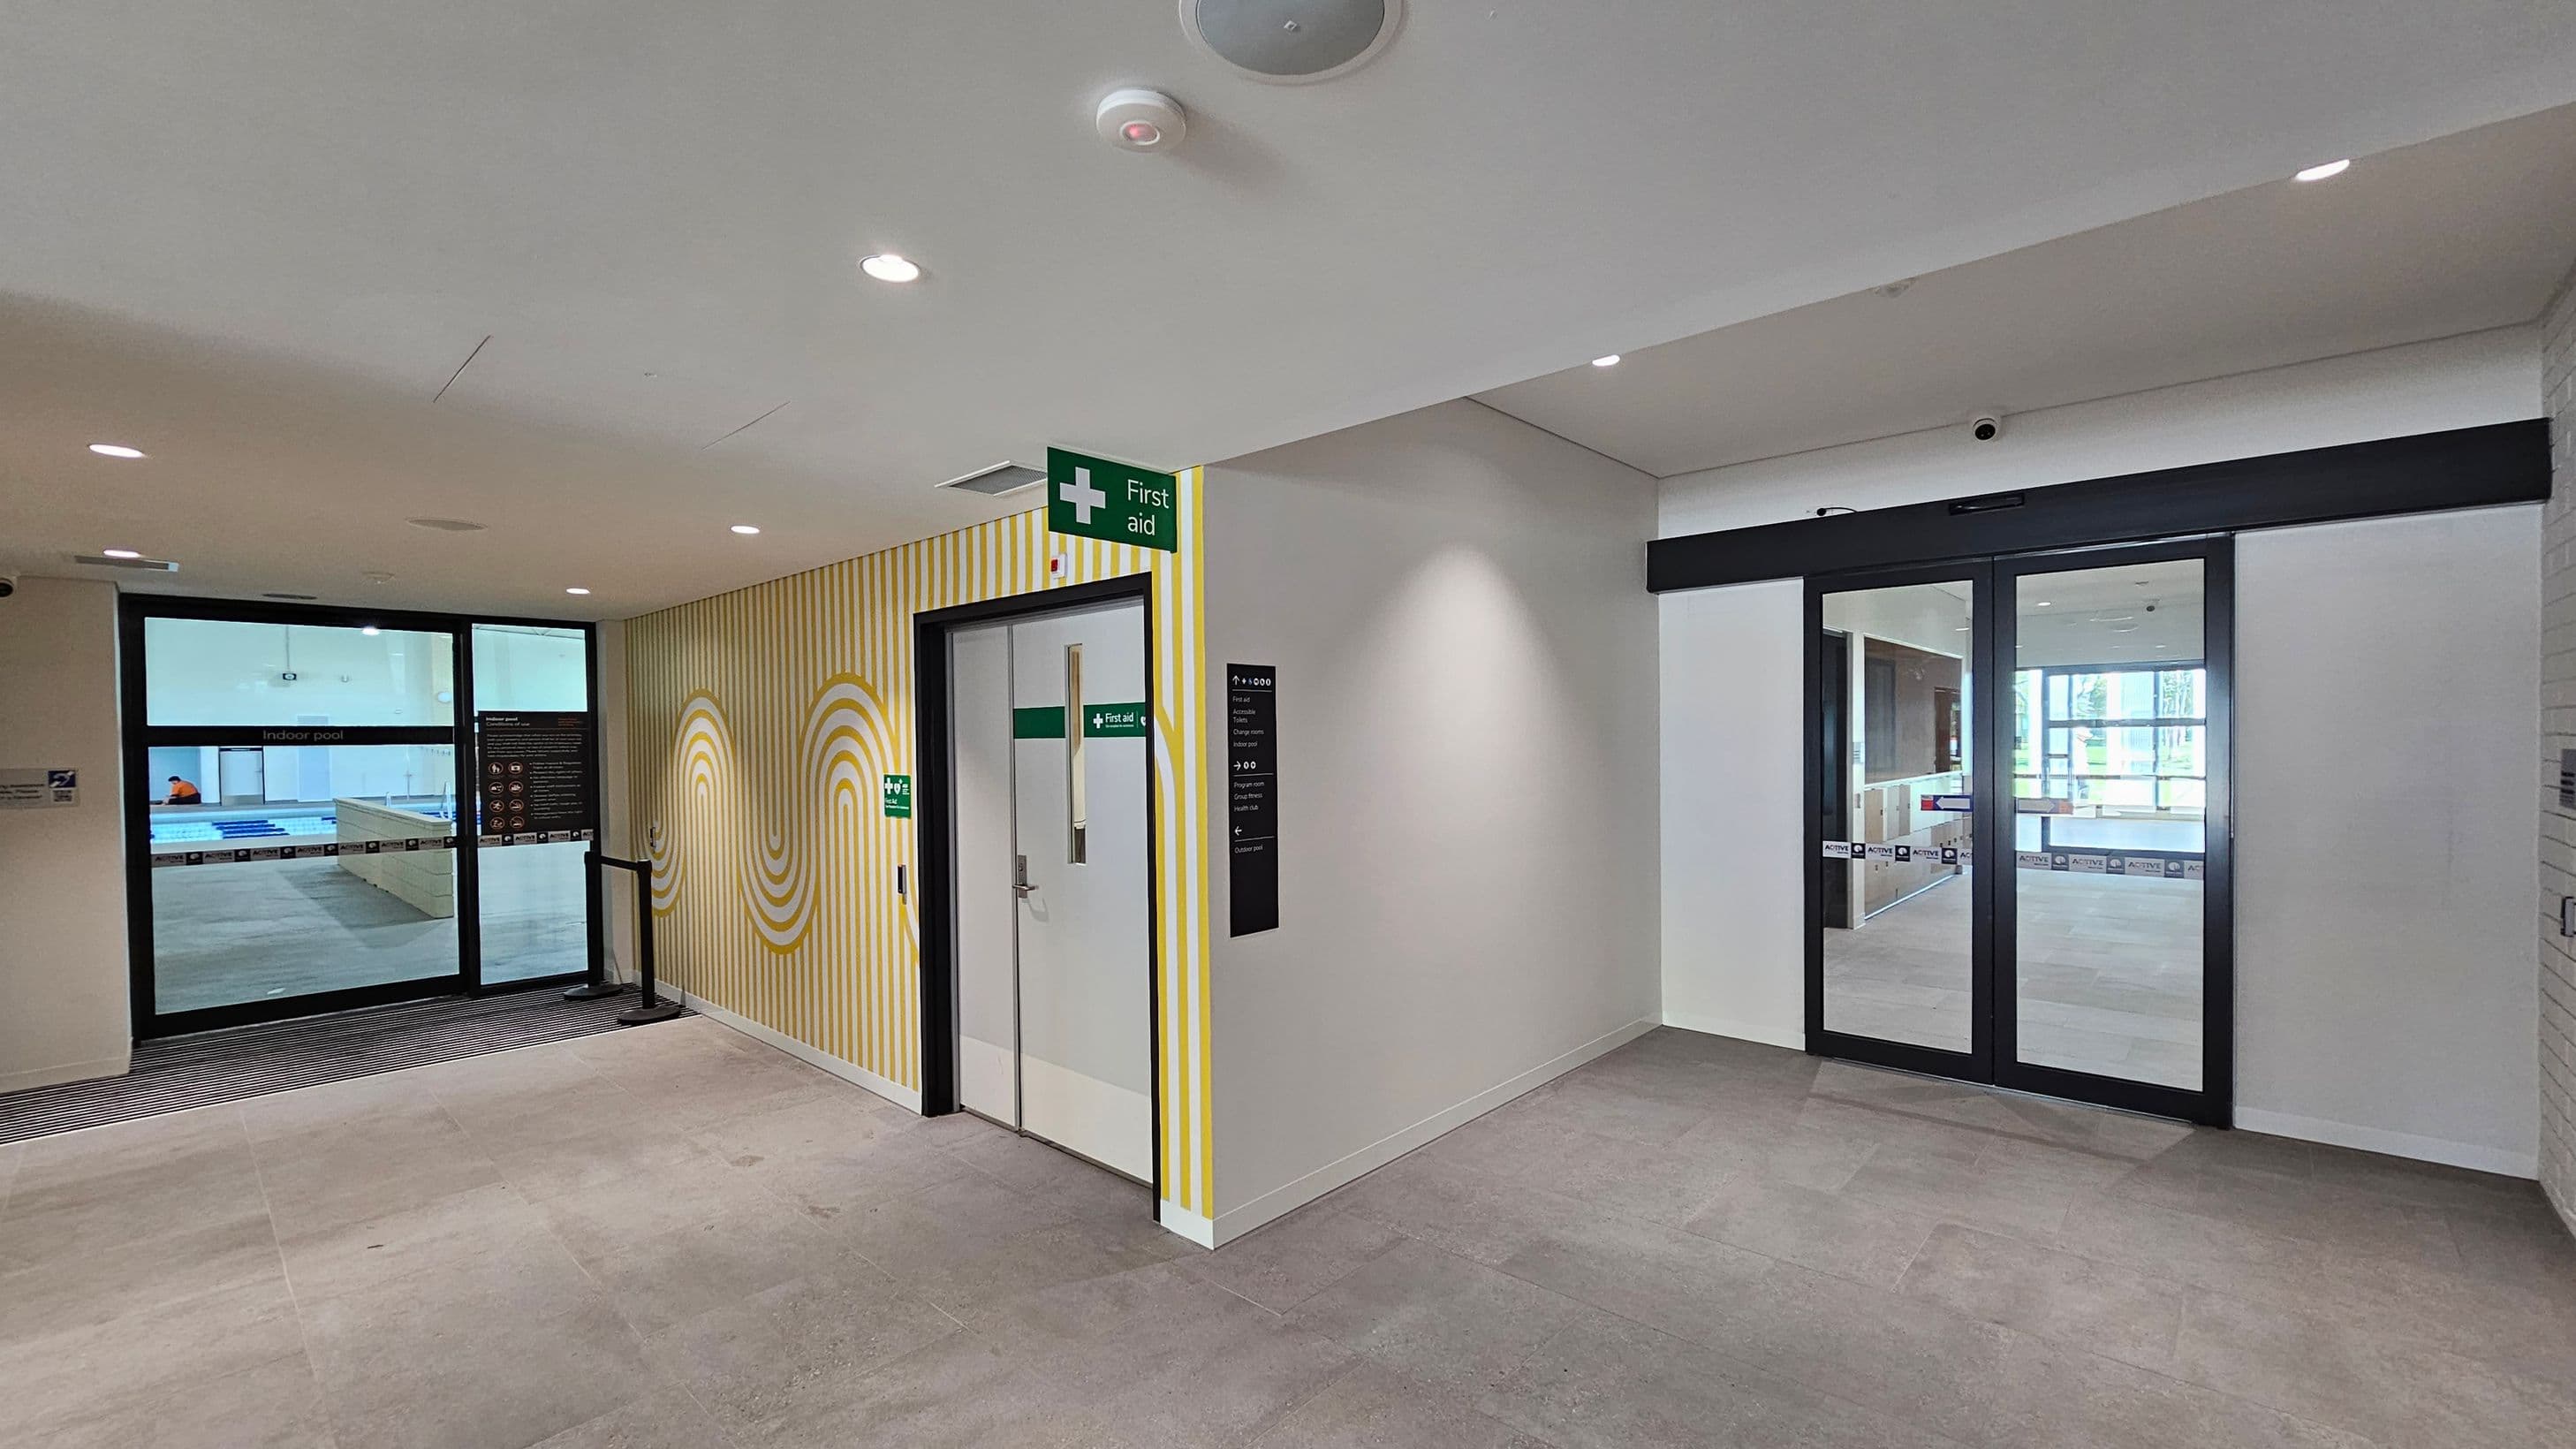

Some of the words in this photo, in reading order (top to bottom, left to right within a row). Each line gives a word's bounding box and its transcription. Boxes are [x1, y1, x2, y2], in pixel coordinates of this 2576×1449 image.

[1127, 478, 1169, 509] First
[1127, 512, 1155, 535] aid
[1105, 712, 1121, 723] First
[1122, 711, 1134, 723] aid
[262, 729, 310, 740] Indoor
[314, 729, 344, 742] pool
